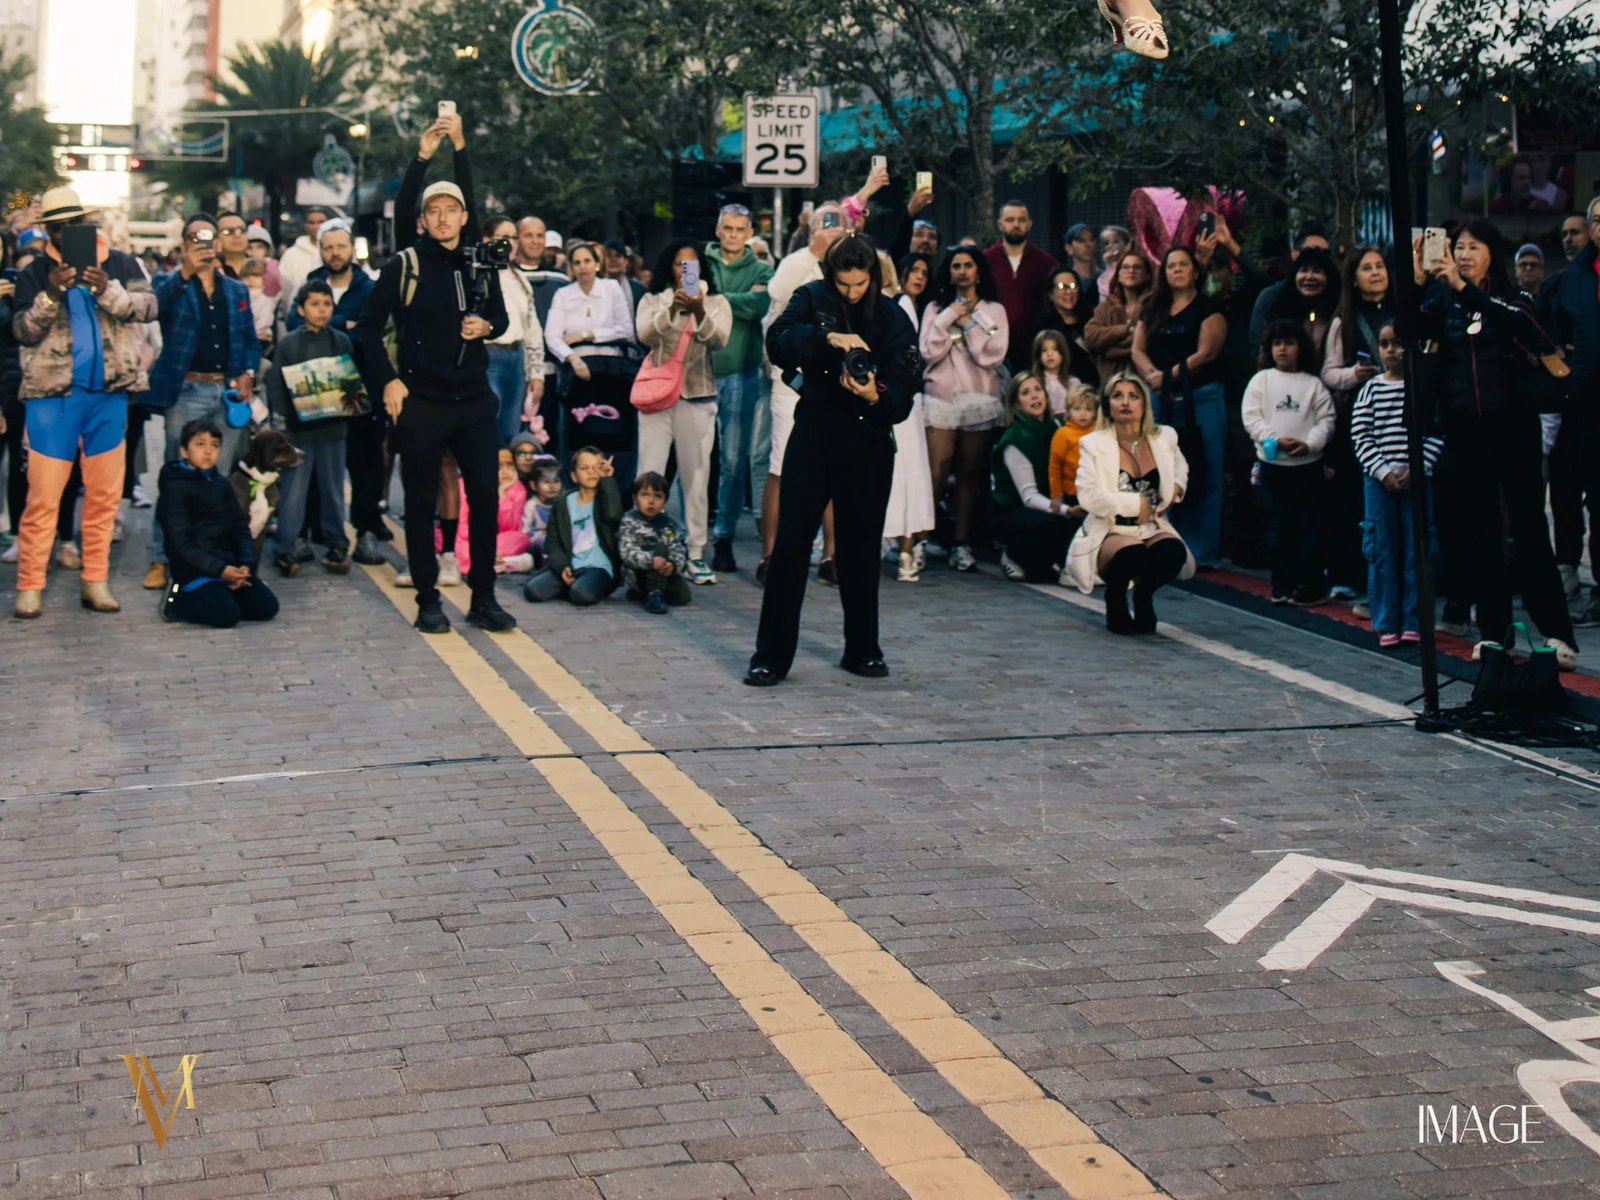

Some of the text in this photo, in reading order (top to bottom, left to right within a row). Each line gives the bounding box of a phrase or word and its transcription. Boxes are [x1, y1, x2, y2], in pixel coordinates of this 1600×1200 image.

[751, 103, 811, 119] SPEED
[757, 124, 804, 138] LIMIT
[754, 143, 807, 176] 25
